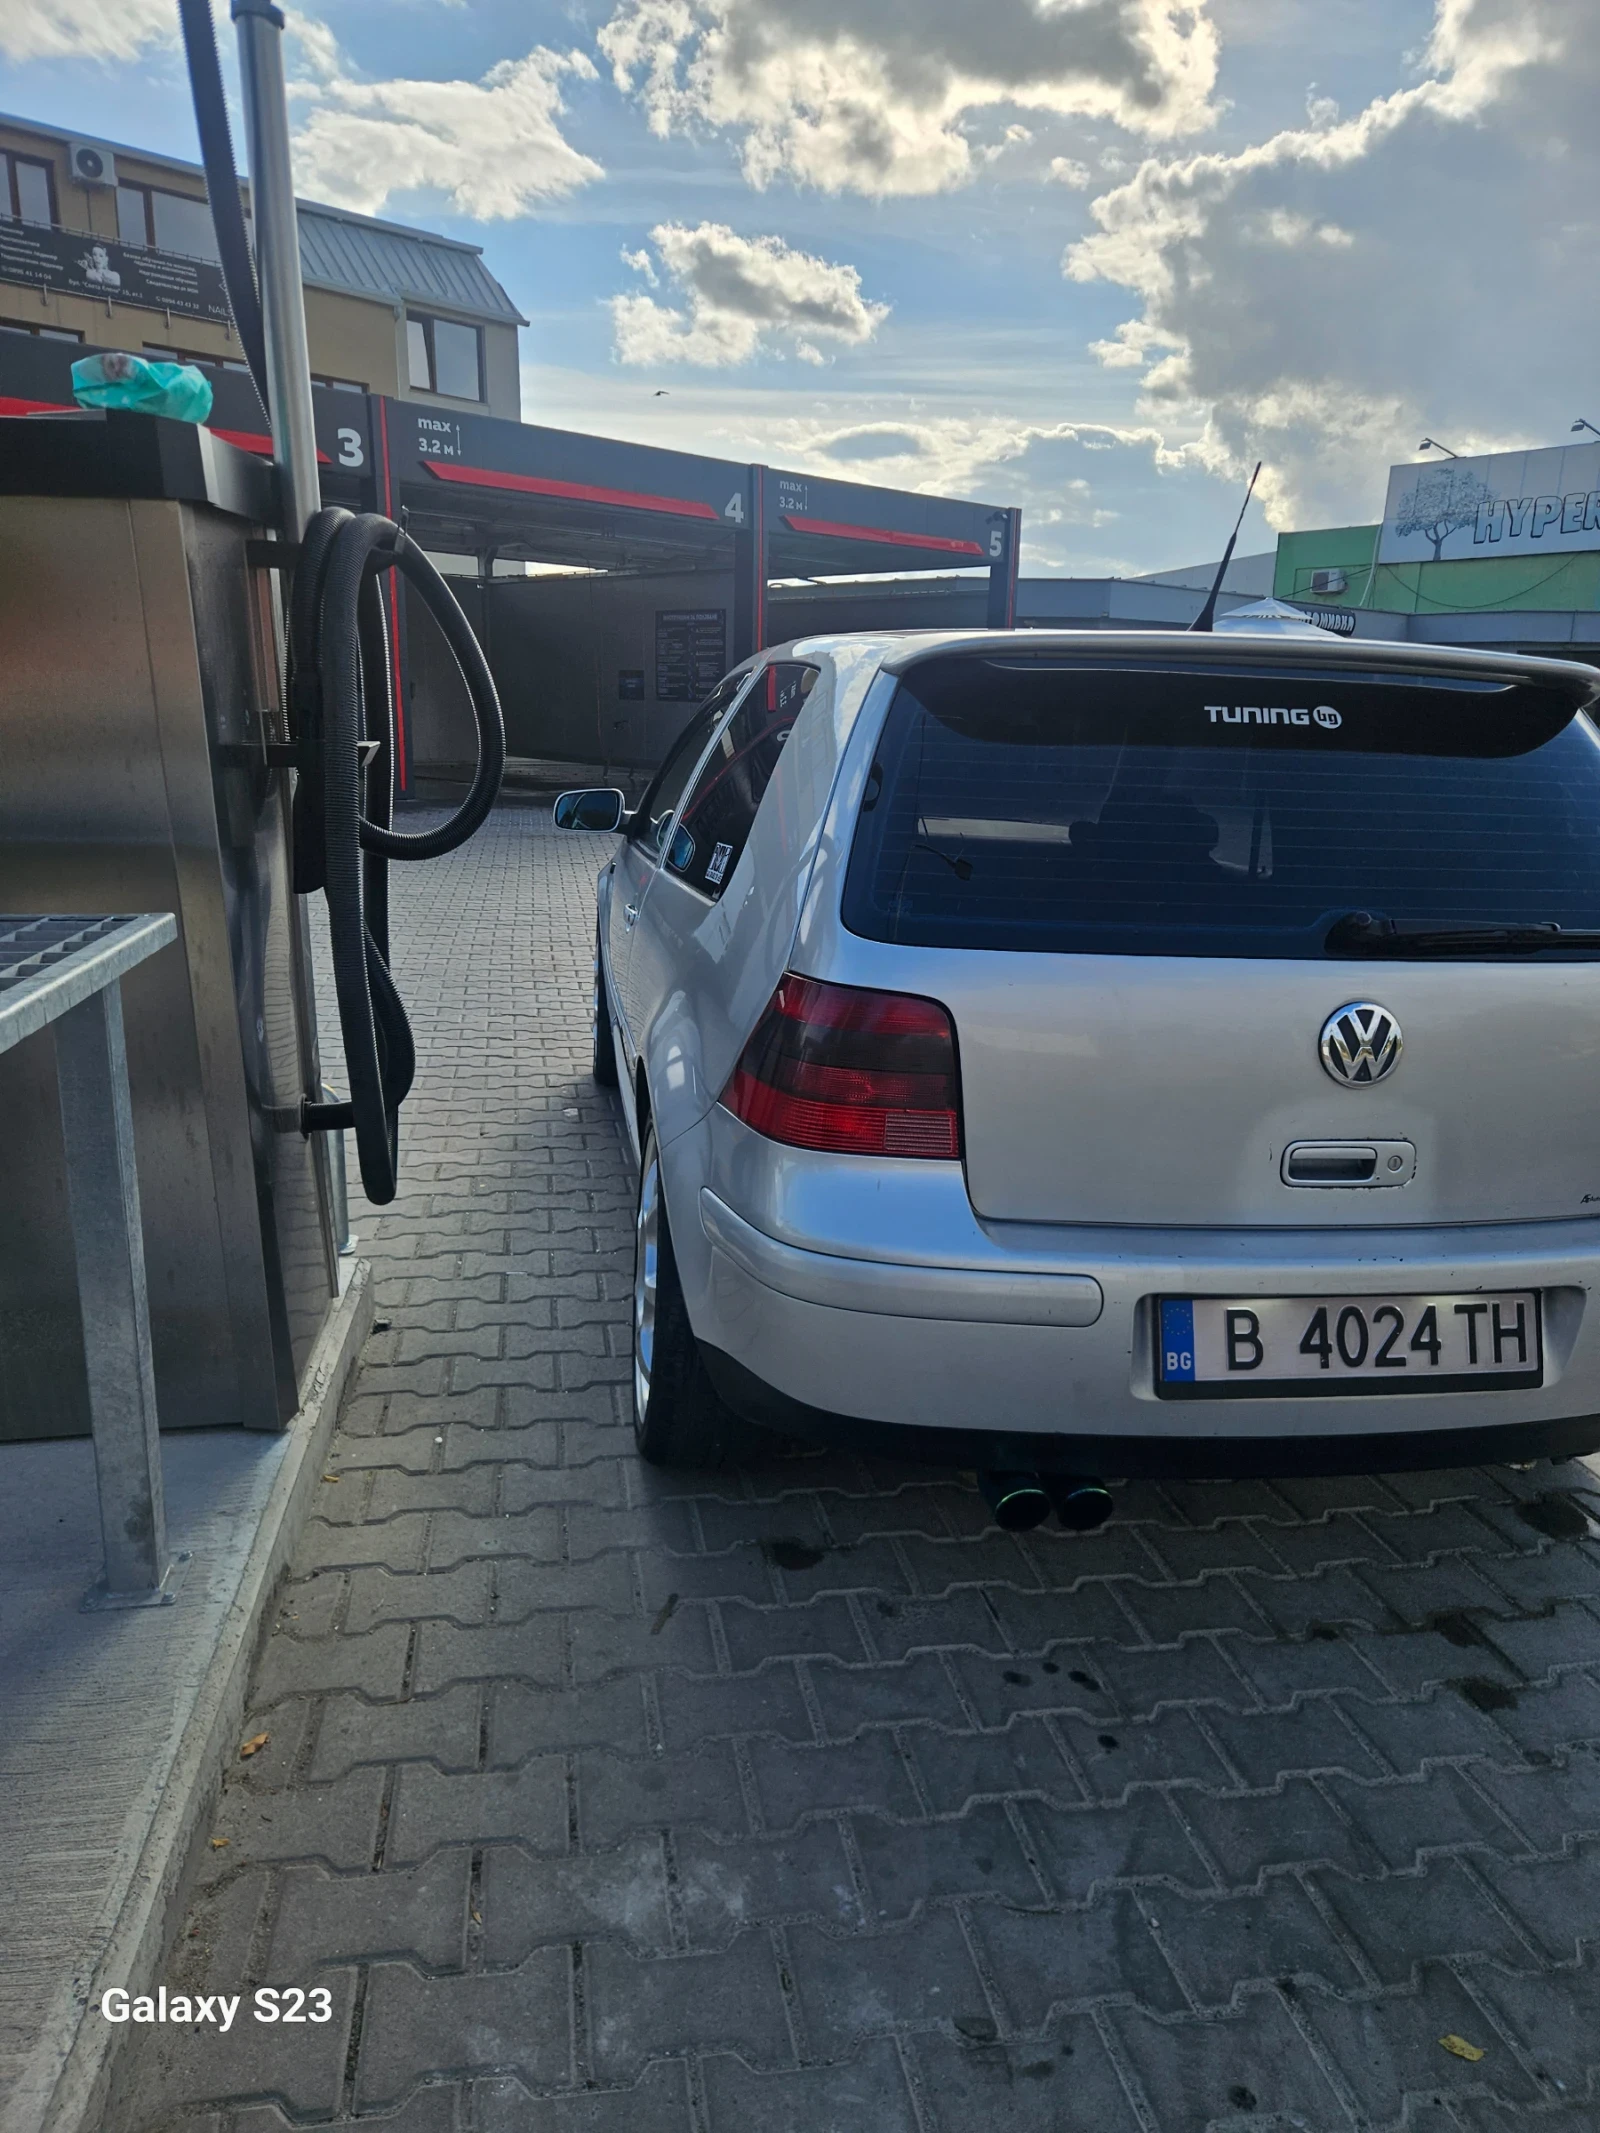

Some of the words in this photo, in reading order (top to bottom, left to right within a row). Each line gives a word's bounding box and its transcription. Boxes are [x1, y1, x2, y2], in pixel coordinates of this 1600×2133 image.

[418, 416, 451, 433] max
[338, 428, 364, 467] 3
[418, 438, 441, 454] 3.2
[779, 480, 802, 492] max
[724, 492, 744, 523] 4
[779, 496, 794, 509] 3.2
[989, 531, 1002, 557] 5
[1204, 706, 1310, 725] TUNING
[1226, 1307, 1265, 1371] B
[1299, 1304, 1442, 1369] 4024
[1454, 1302, 1529, 1365] TH
[1166, 1351, 1192, 1371] BG
